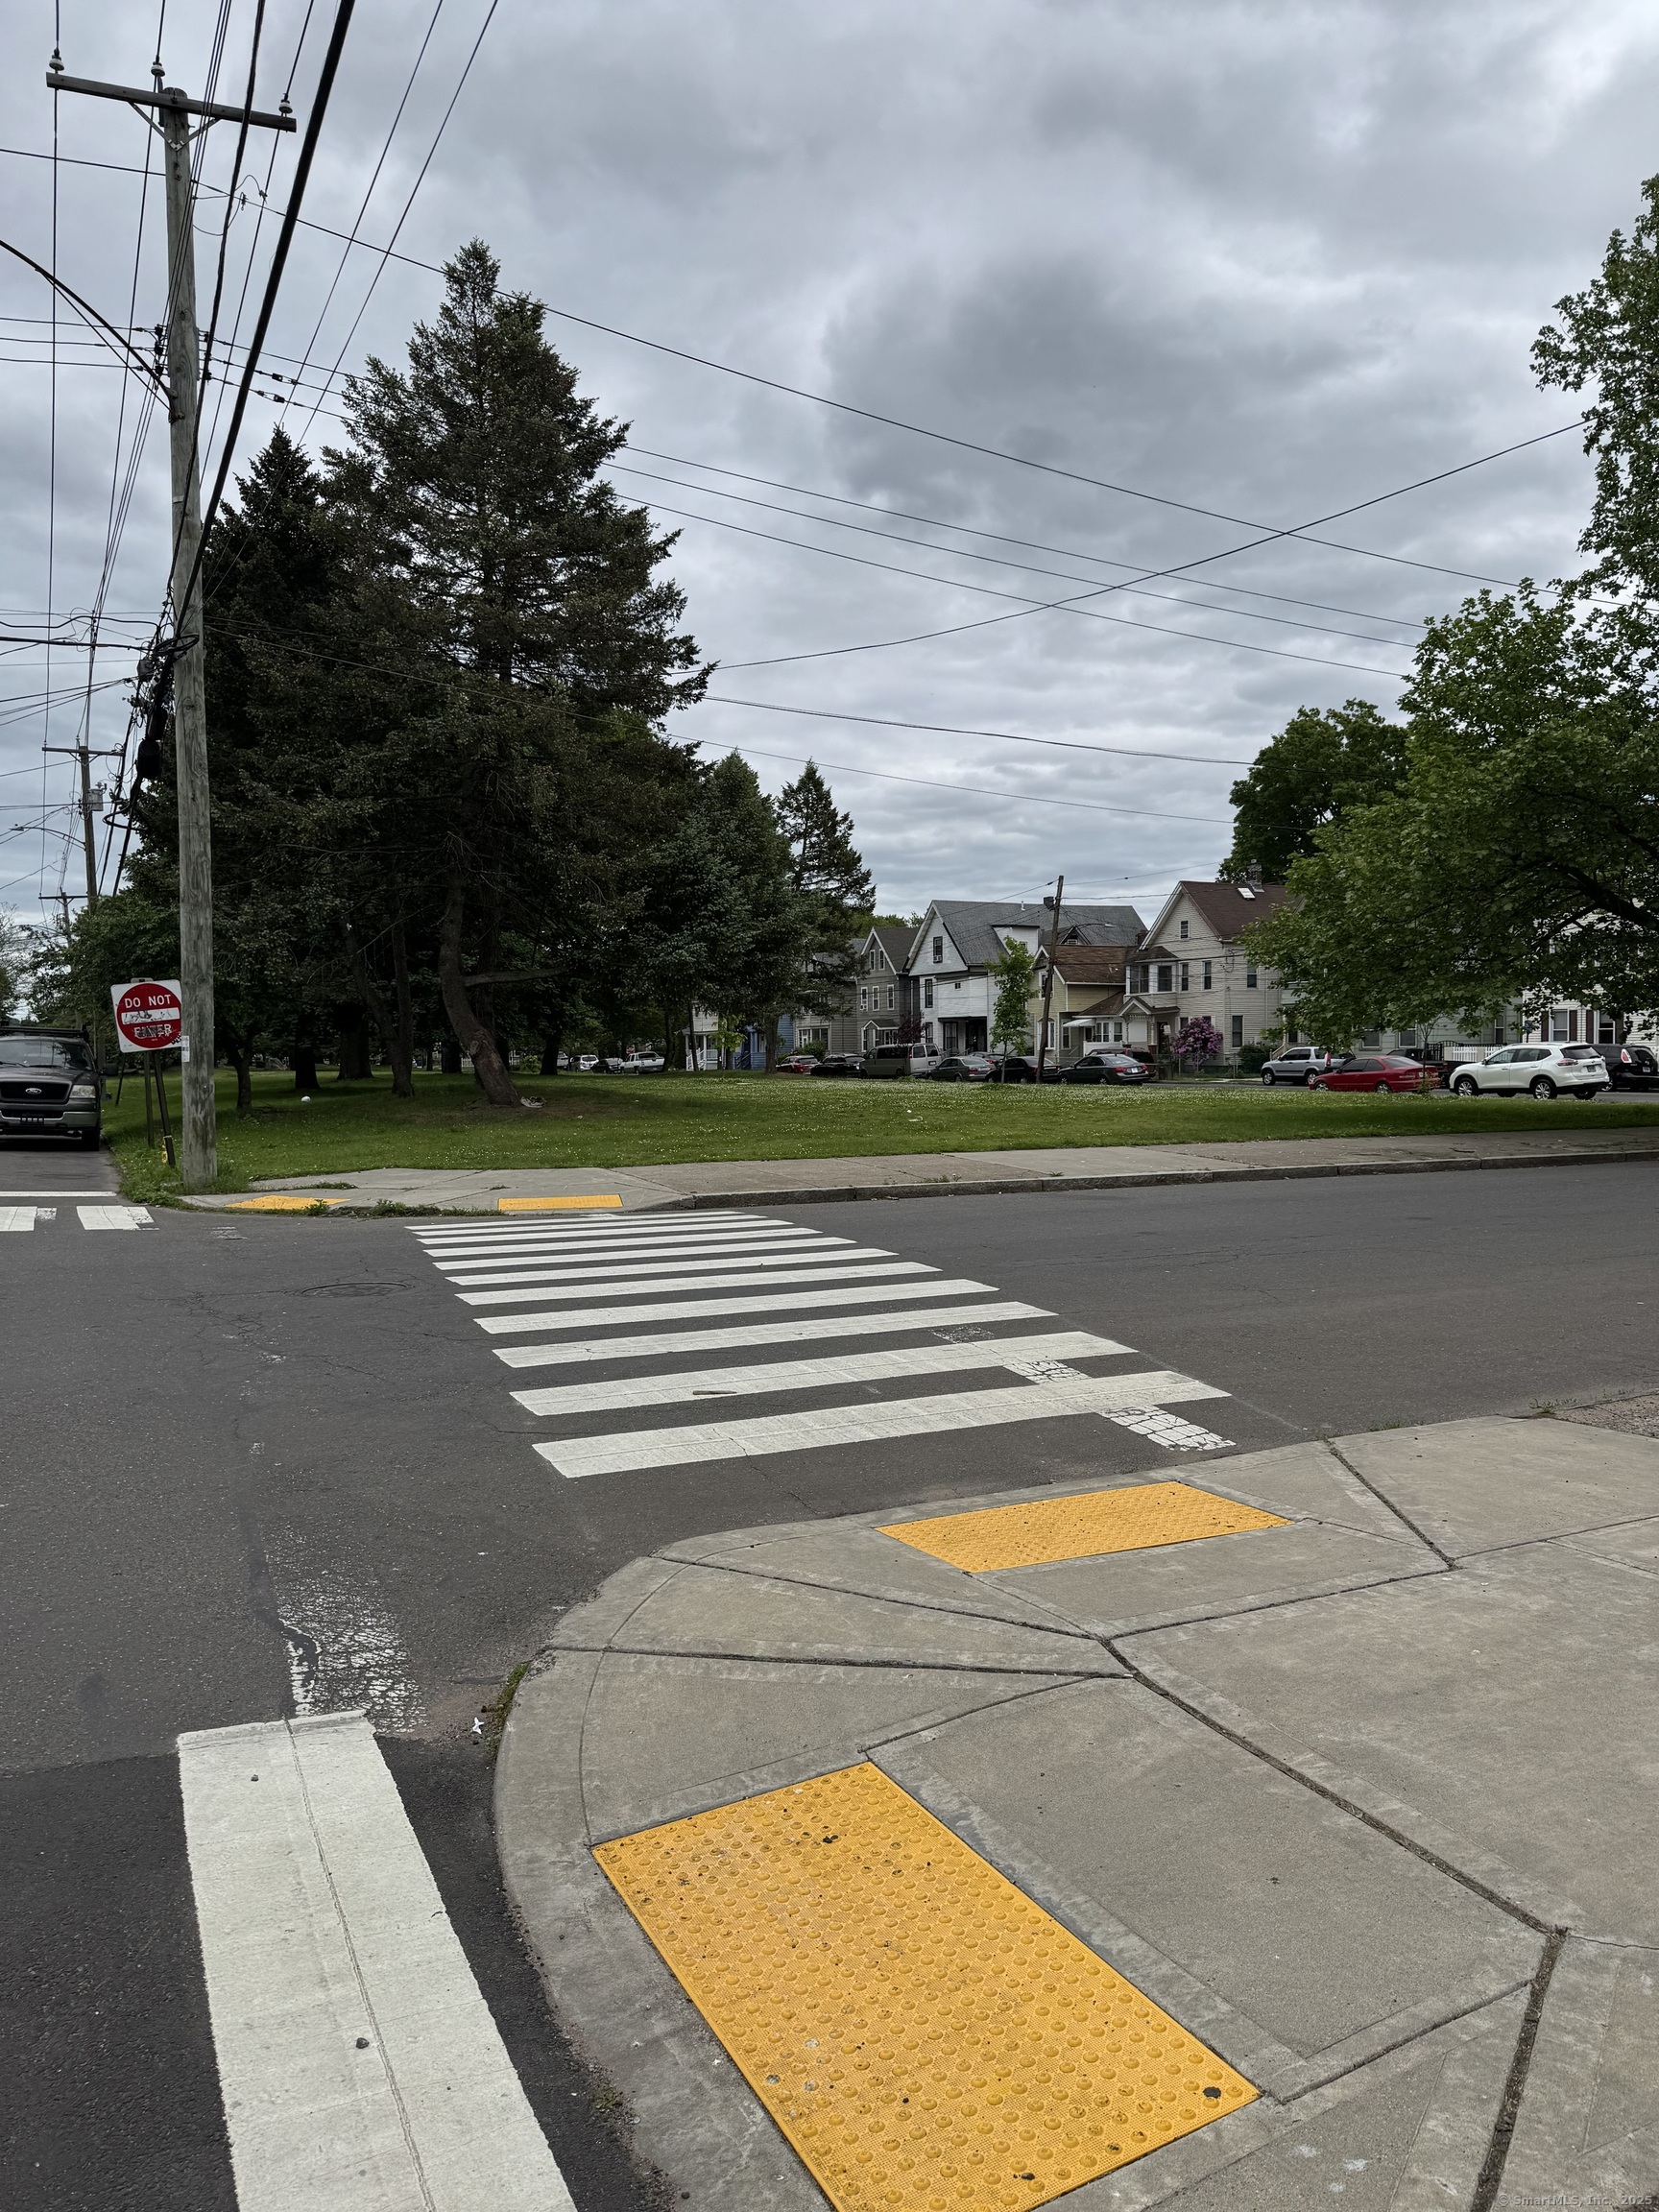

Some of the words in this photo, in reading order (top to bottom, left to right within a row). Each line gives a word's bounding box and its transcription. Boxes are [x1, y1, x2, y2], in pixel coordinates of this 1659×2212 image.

[124, 997, 141, 1009] DO
[148, 994, 172, 1006] NOT
[133, 1023, 172, 1039] ETER
